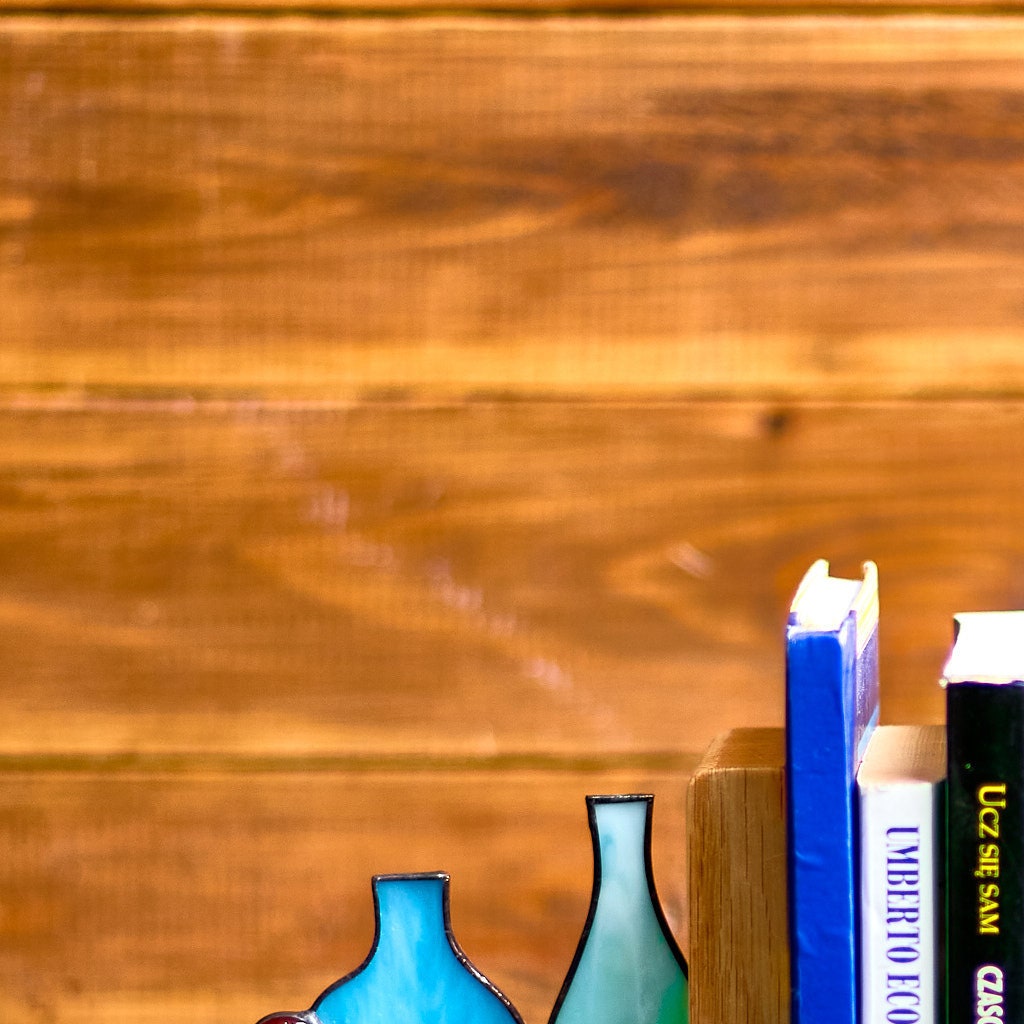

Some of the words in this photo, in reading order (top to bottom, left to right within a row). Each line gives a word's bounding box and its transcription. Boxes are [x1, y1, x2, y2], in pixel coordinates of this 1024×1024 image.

[974, 844, 1000, 878] SIĘ
[886, 826, 920, 965] UMBERTO
[978, 883, 1000, 934] SAM
